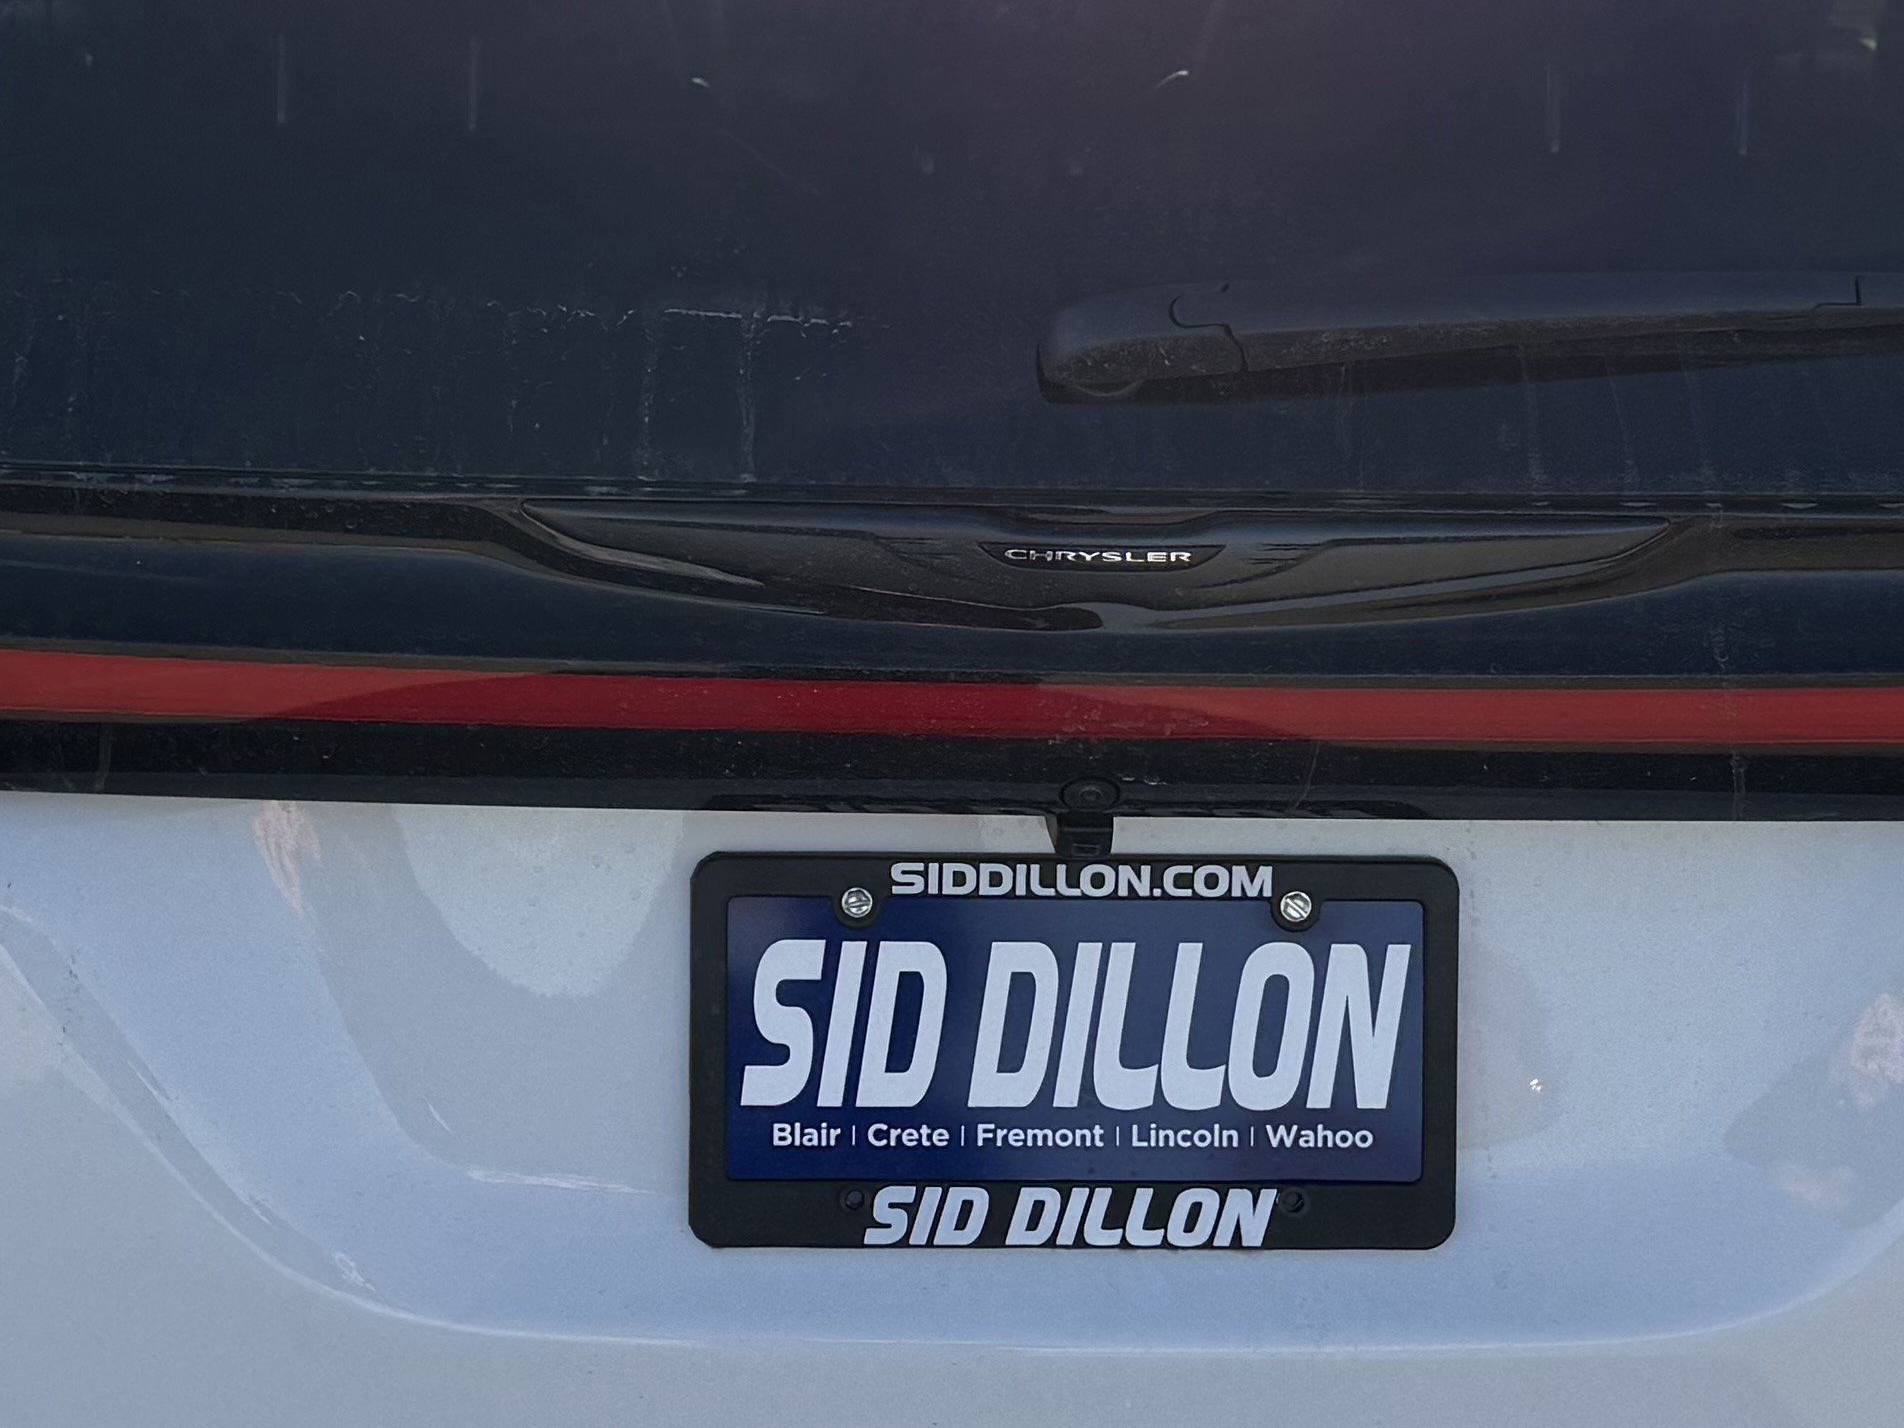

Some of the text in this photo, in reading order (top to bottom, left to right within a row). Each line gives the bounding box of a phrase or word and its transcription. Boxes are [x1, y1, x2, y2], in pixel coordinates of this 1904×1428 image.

[1003, 548, 1193, 563] CHRYSLER
[890, 861, 1274, 898] SIDDILLON.COM
[739, 938, 1413, 1112] SID DILLON
[772, 1122, 1375, 1149] Blair Crete Fremont Lincoln Wahoo
[862, 1184, 1280, 1249] SID DILLON
